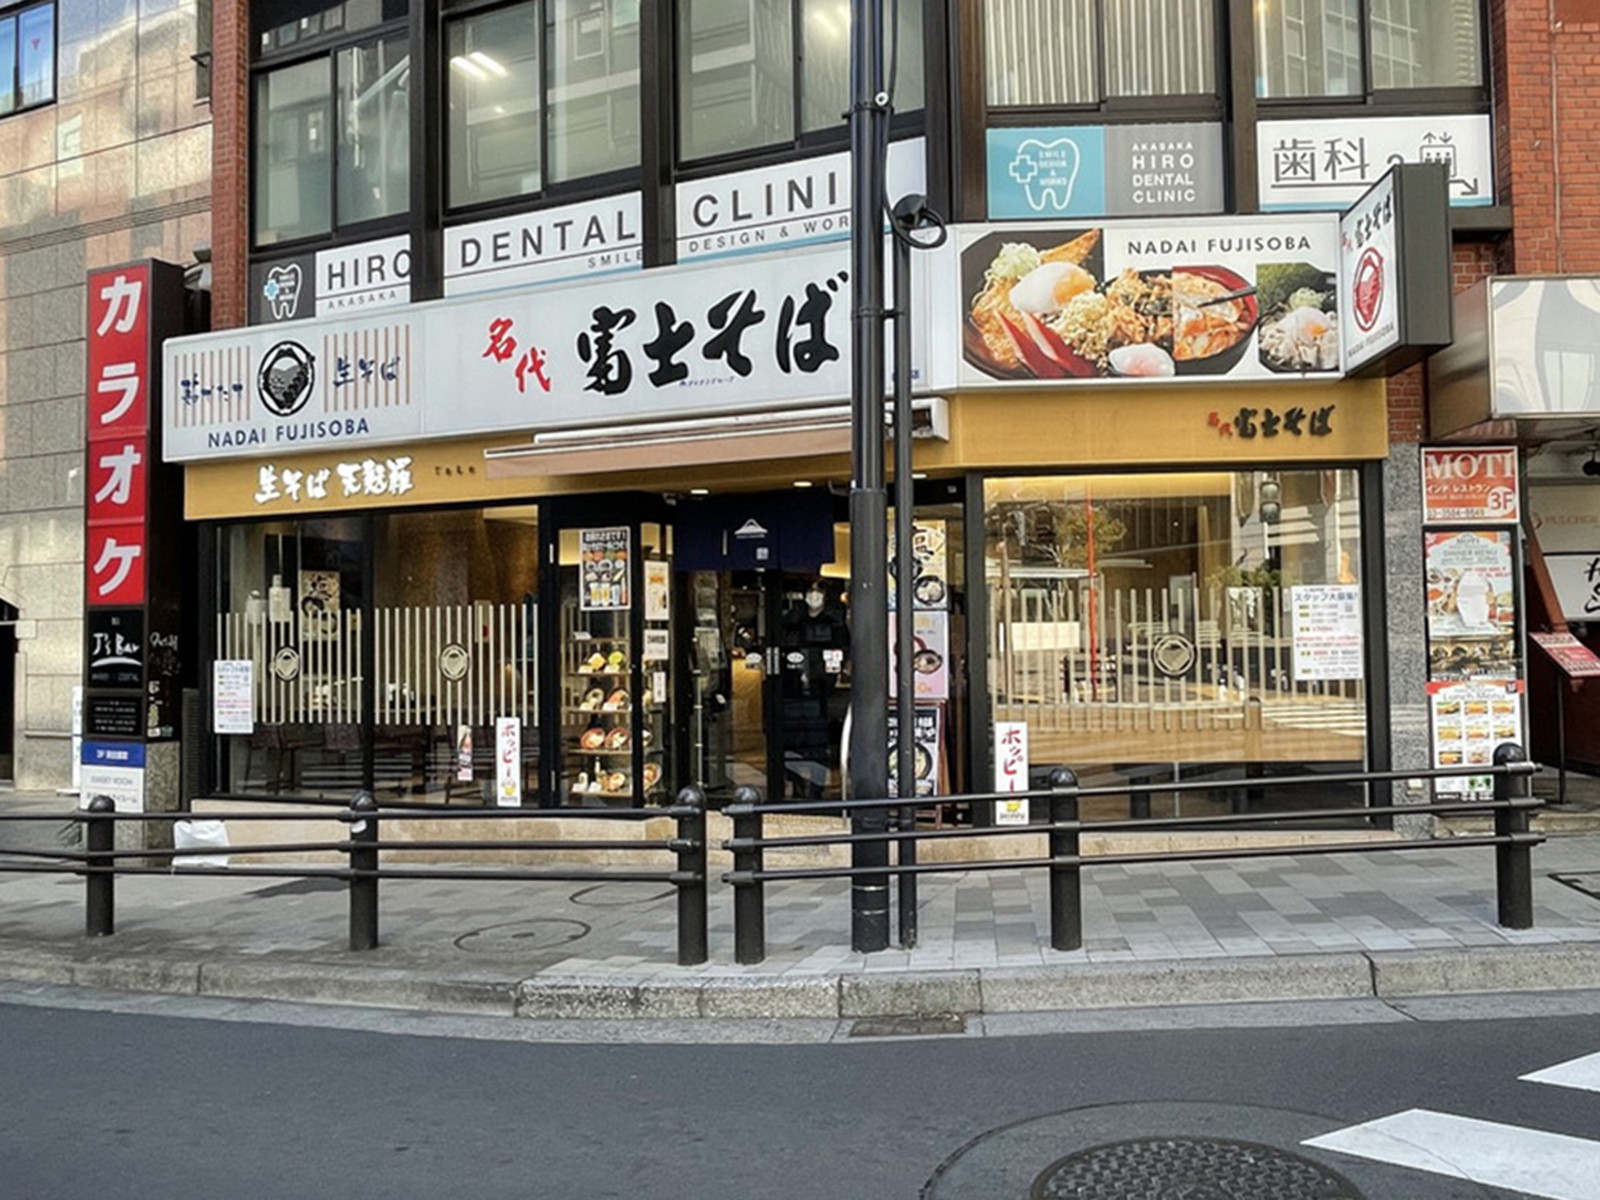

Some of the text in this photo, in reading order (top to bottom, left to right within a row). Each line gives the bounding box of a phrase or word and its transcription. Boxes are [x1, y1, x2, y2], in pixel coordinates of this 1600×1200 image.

[1132, 142, 1193, 151] AKASAKA
[1132, 153, 1194, 170] HIRO
[1272, 136, 1370, 182] 歯科
[1132, 173, 1194, 187] DENTAL
[1132, 188, 1196, 203] CLINIC
[327, 250, 412, 291] HIRO
[461, 210, 636, 268] DENTAL
[692, 171, 839, 228] CLINI
[1128, 234, 1312, 256] NADAI FUJISOBA
[328, 290, 397, 310] AKASAKA
[689, 229, 766, 254] DESIGN
[780, 227, 790, 238] &
[803, 215, 849, 233] WOR
[483, 271, 850, 396] 名代 富士そば
[93, 273, 142, 597] カラオケ
[208, 417, 370, 448] NADAI FUJISOBA
[1234, 404, 1336, 439] 富士そば
[1424, 453, 1514, 479] MOTI
[255, 464, 331, 503] 生そば
[1491, 492, 1513, 509] 3F
[1001, 726, 1024, 793] ホッピー
